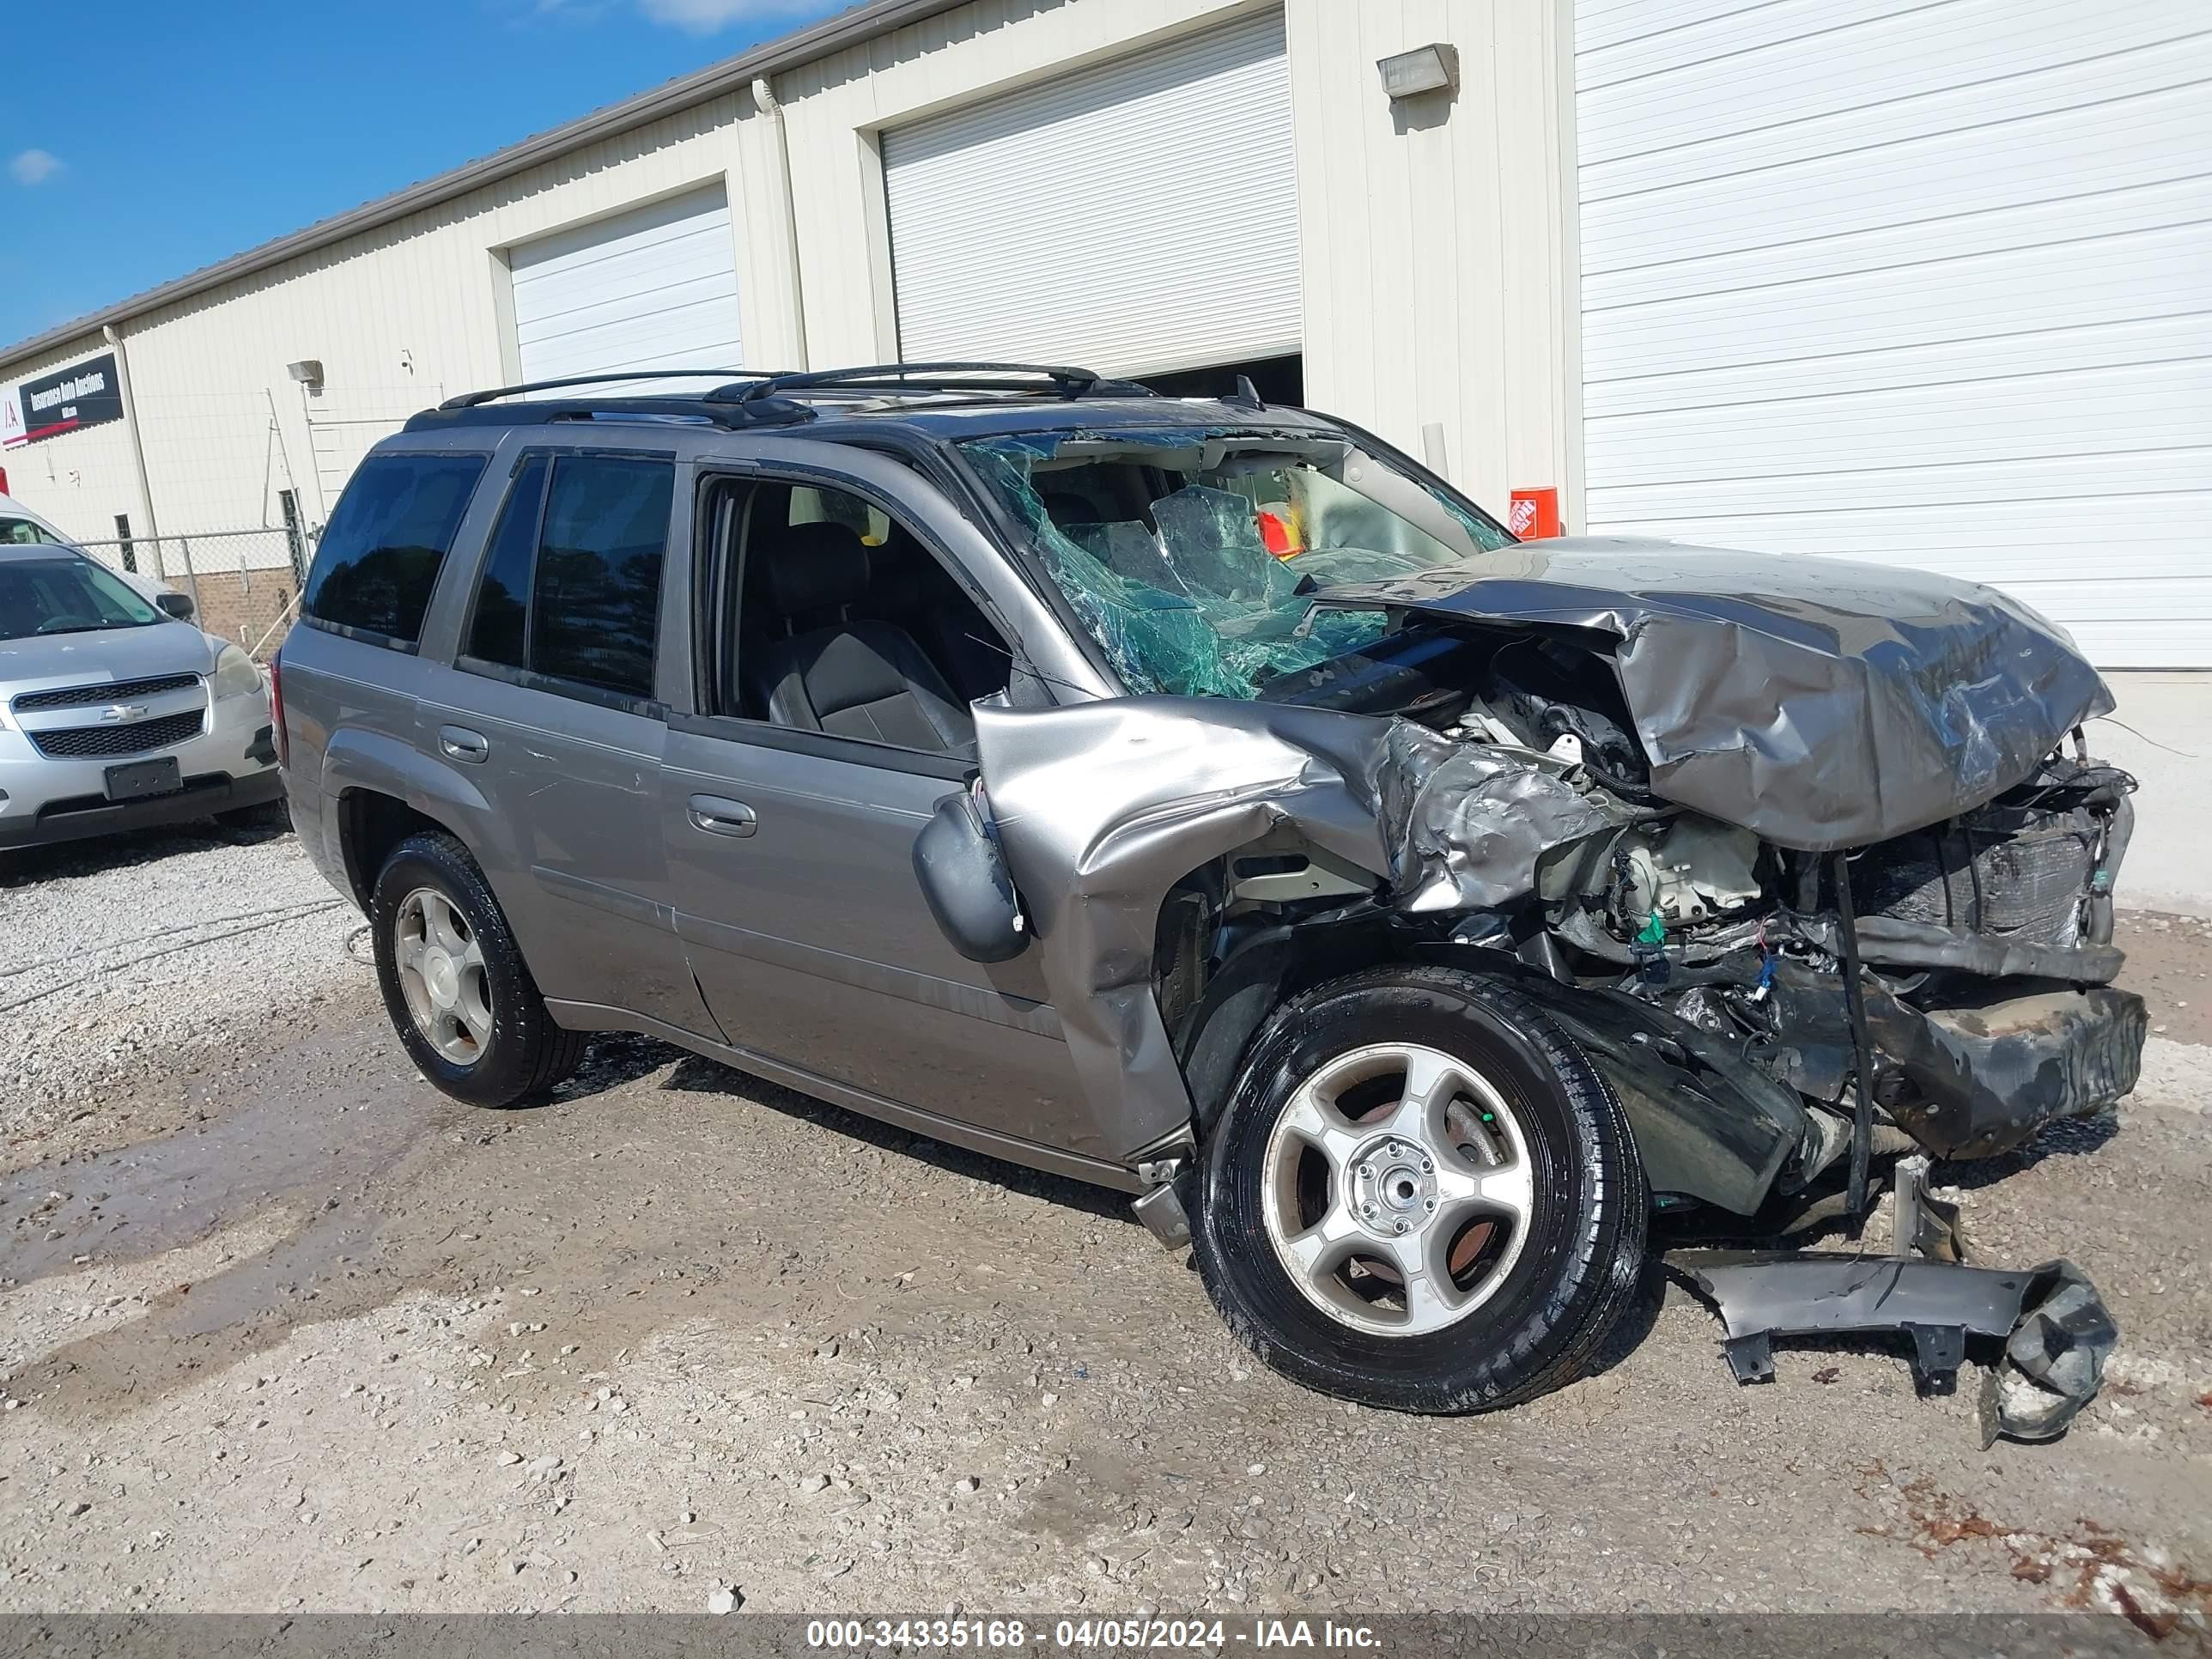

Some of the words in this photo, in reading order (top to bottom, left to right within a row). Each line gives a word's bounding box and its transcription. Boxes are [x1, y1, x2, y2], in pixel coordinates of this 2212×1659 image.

[31, 386, 61, 411] Insurance
[61, 381, 76, 402] Auto
[75, 372, 104, 397] Auctions
